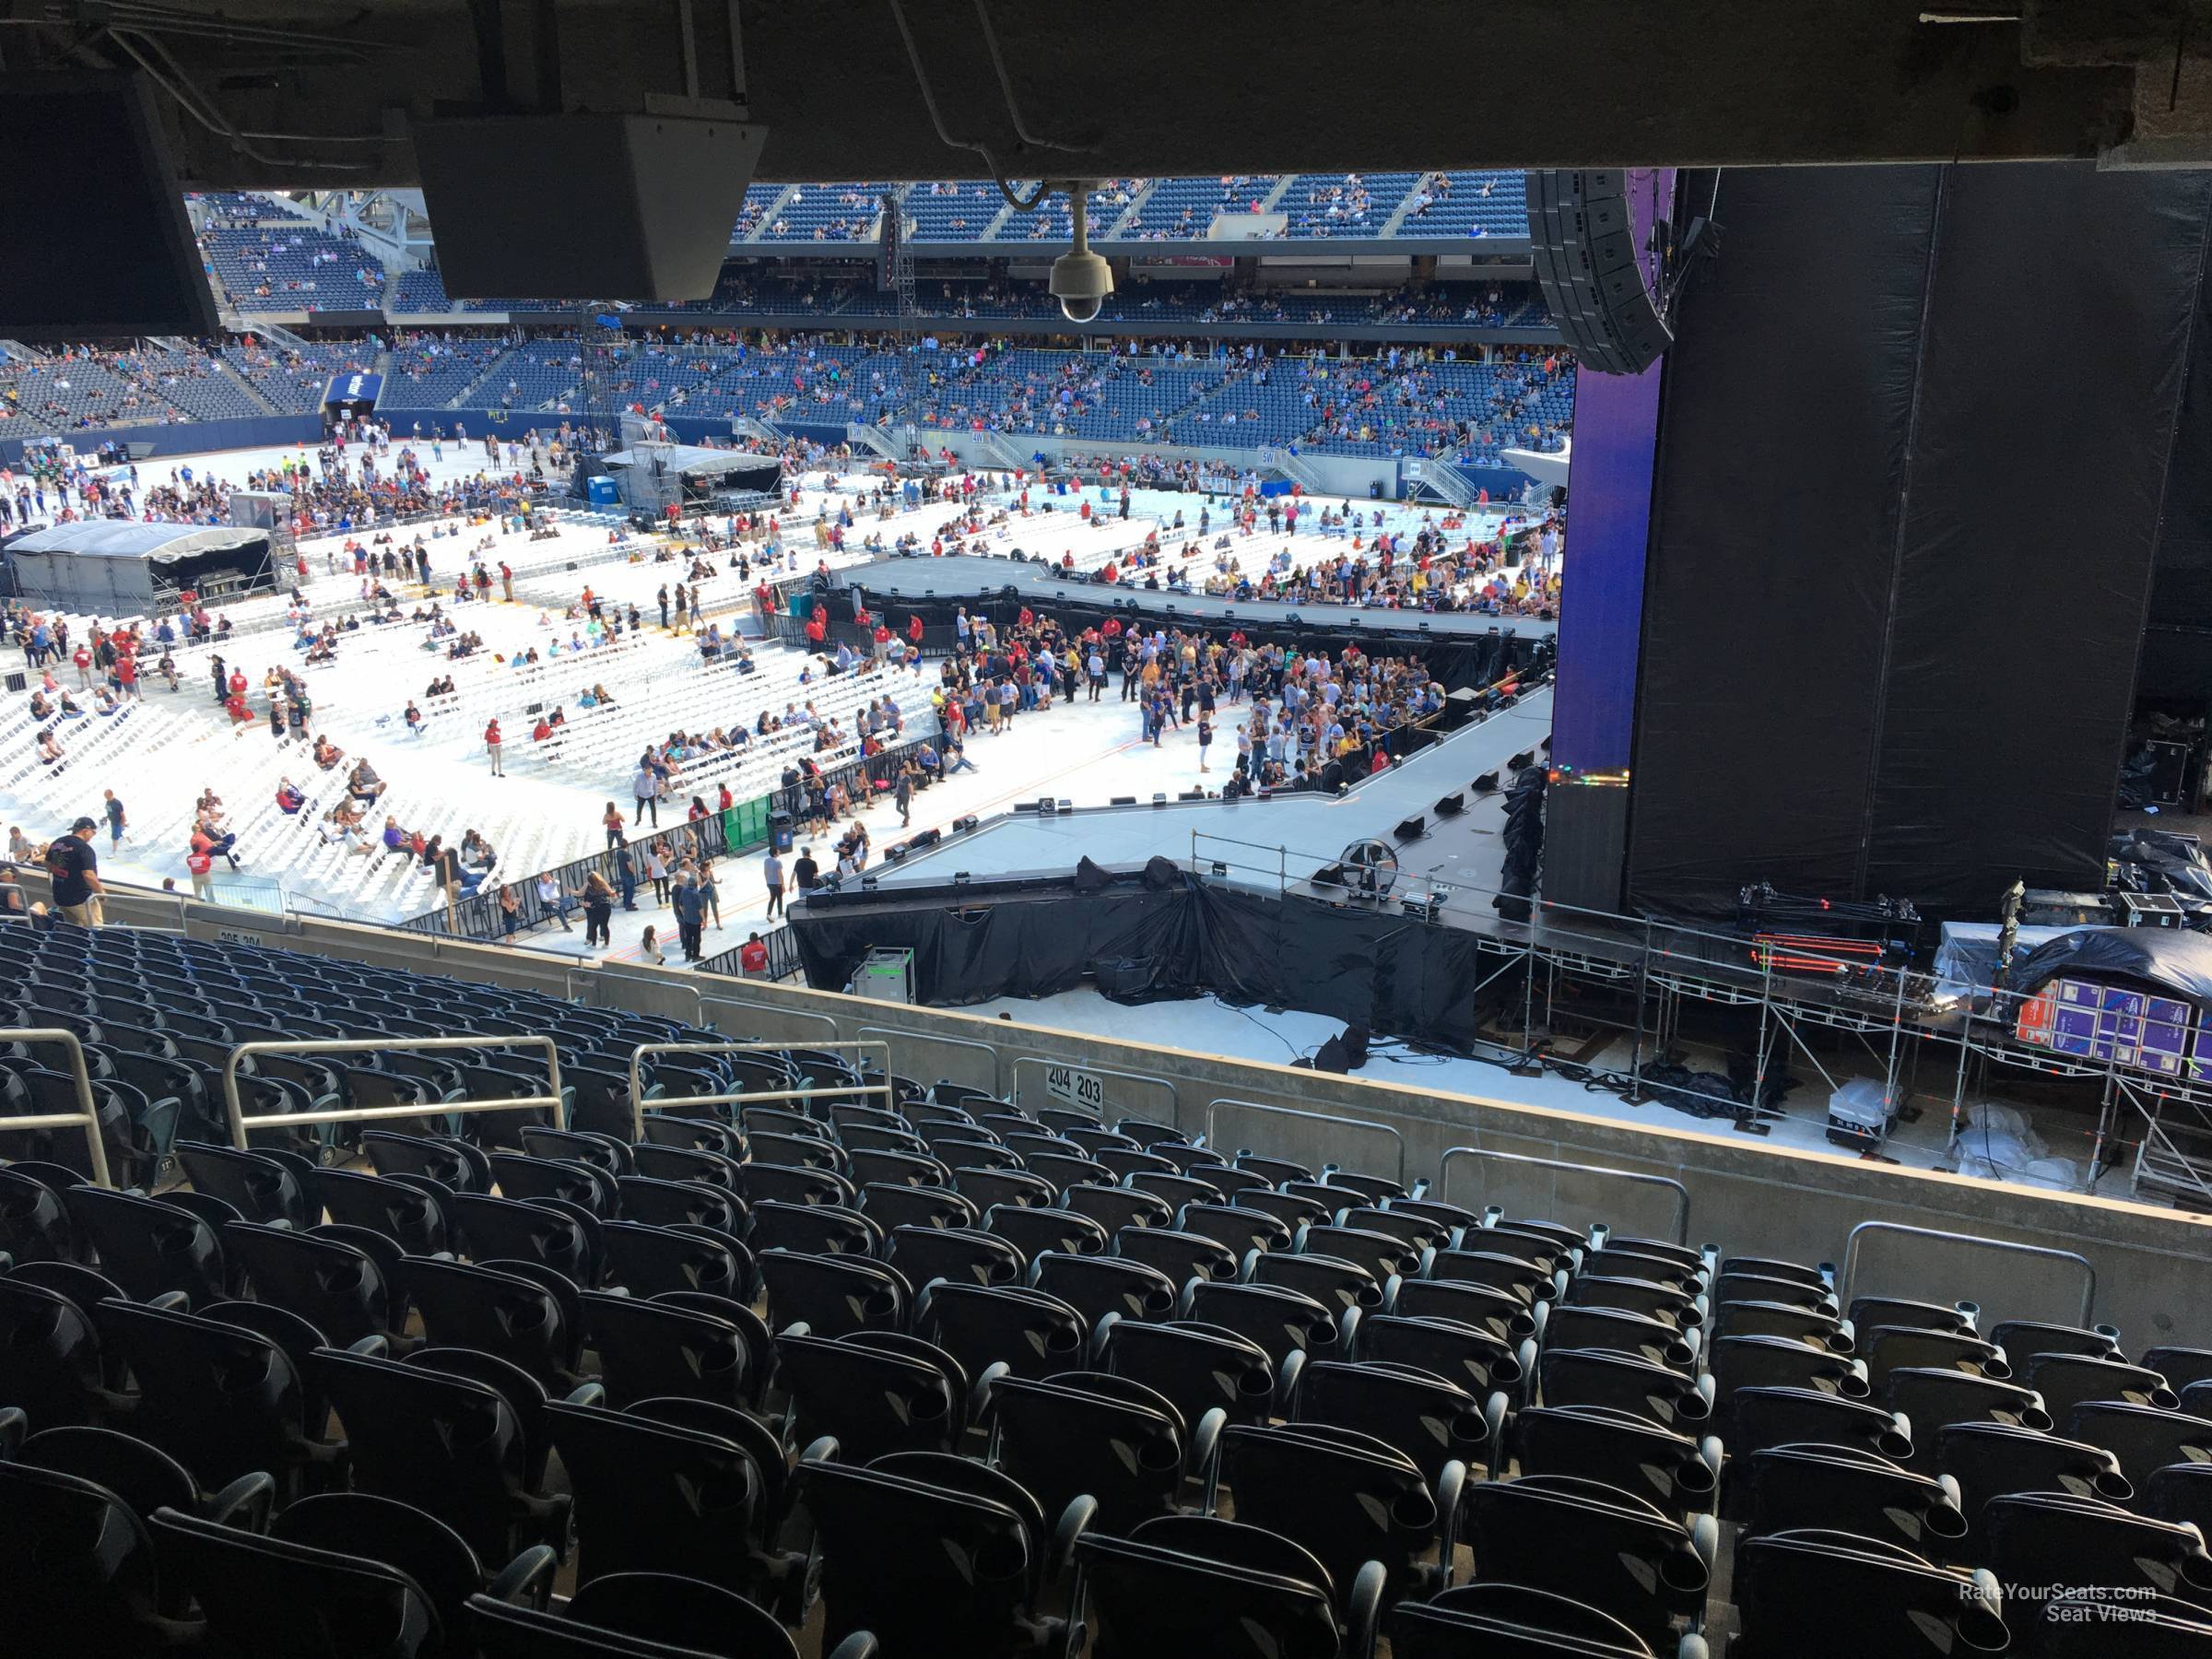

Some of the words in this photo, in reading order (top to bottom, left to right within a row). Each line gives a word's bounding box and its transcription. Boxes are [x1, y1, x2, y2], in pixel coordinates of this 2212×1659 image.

[1263, 453, 1275, 464] 5W
[1048, 1067, 1071, 1090] 204
[1077, 1075, 1100, 1103] 203
